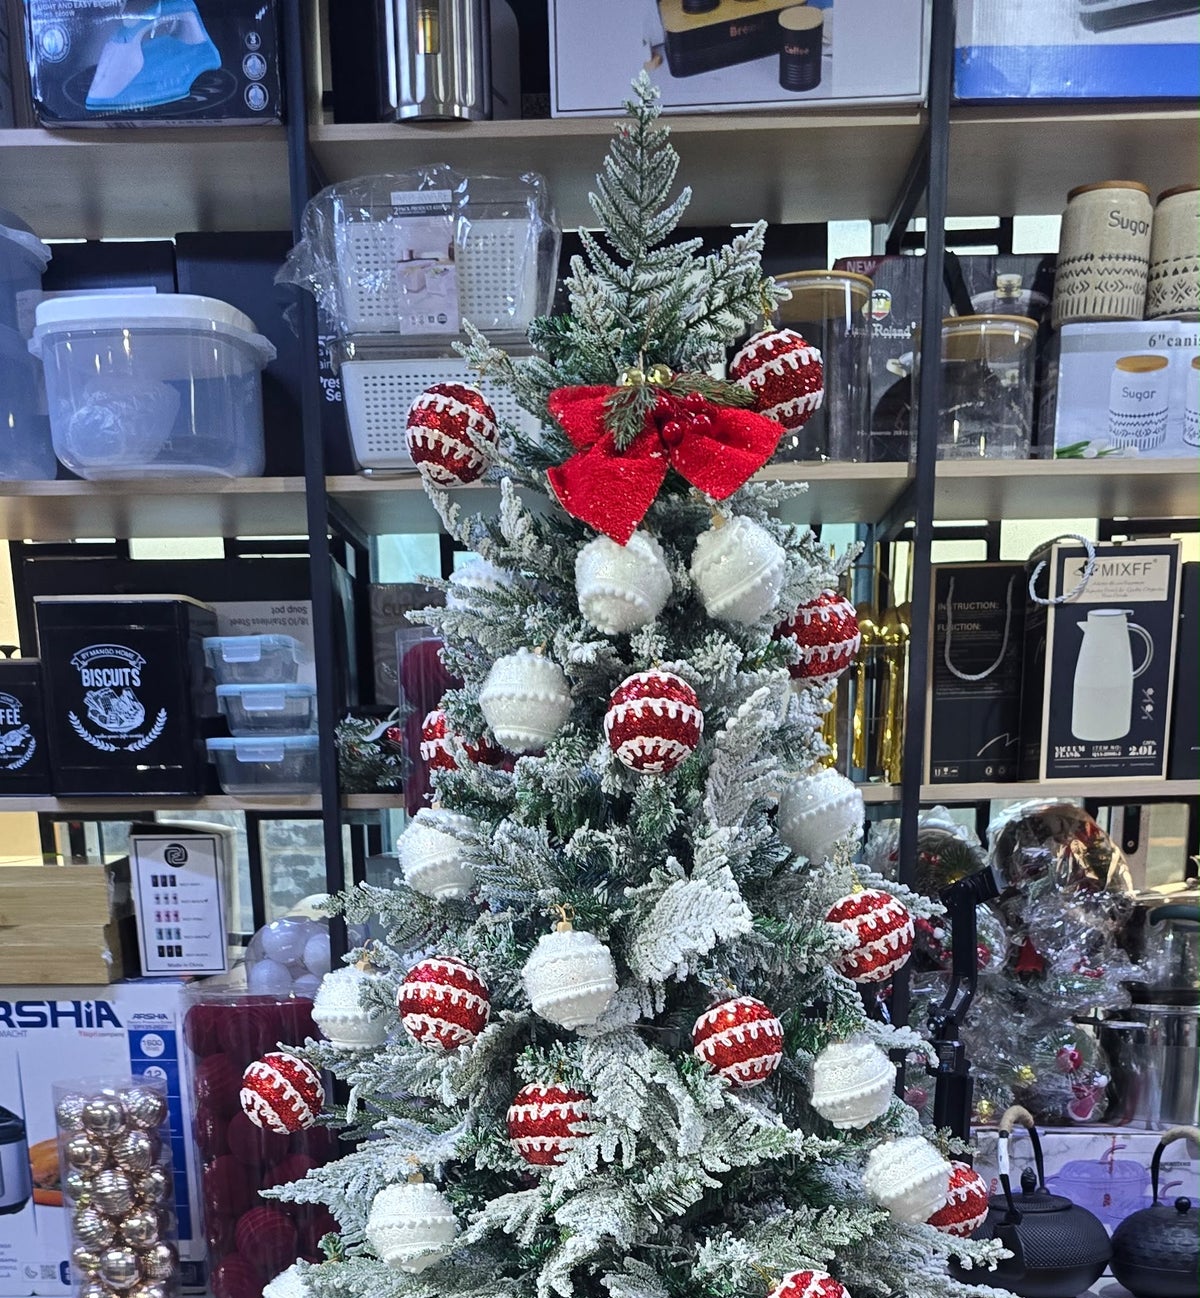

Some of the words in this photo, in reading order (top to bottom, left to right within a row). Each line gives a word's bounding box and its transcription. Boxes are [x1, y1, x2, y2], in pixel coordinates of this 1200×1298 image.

[1108, 209, 1150, 236] Sugar
[846, 260, 876, 273] NEW
[1148, 334, 1200, 348] 6"cani
[1122, 386, 1157, 402] Sugar
[1101, 562, 1152, 577] MIXFF
[271, 606, 286, 615] pot
[287, 605, 308, 615] Soup
[937, 601, 1000, 611] INTRUCTION:
[81, 667, 142, 687] BISCUITS
[1128, 745, 1157, 756] 2.0L
